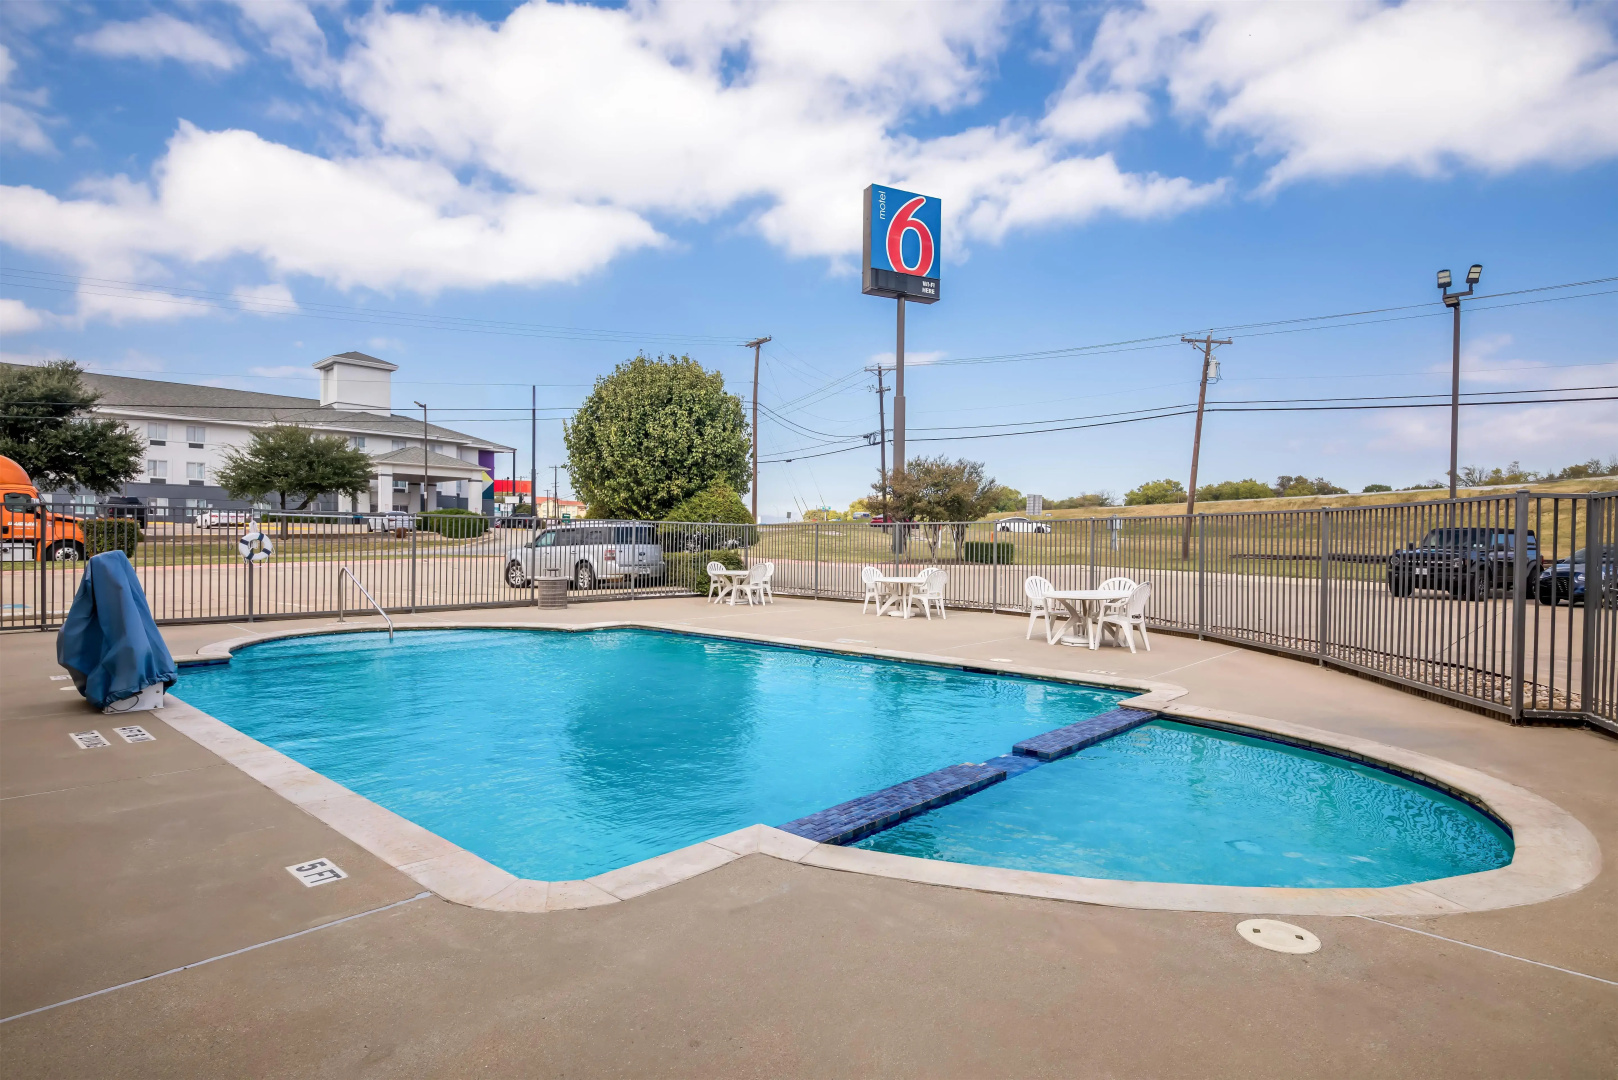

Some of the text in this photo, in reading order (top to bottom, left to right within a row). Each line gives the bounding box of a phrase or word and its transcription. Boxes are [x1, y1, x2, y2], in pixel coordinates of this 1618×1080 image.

[878, 190, 886, 220] motel
[886, 196, 935, 277] 6
[922, 287, 935, 295] HERE
[295, 860, 342, 884] 5 FT
